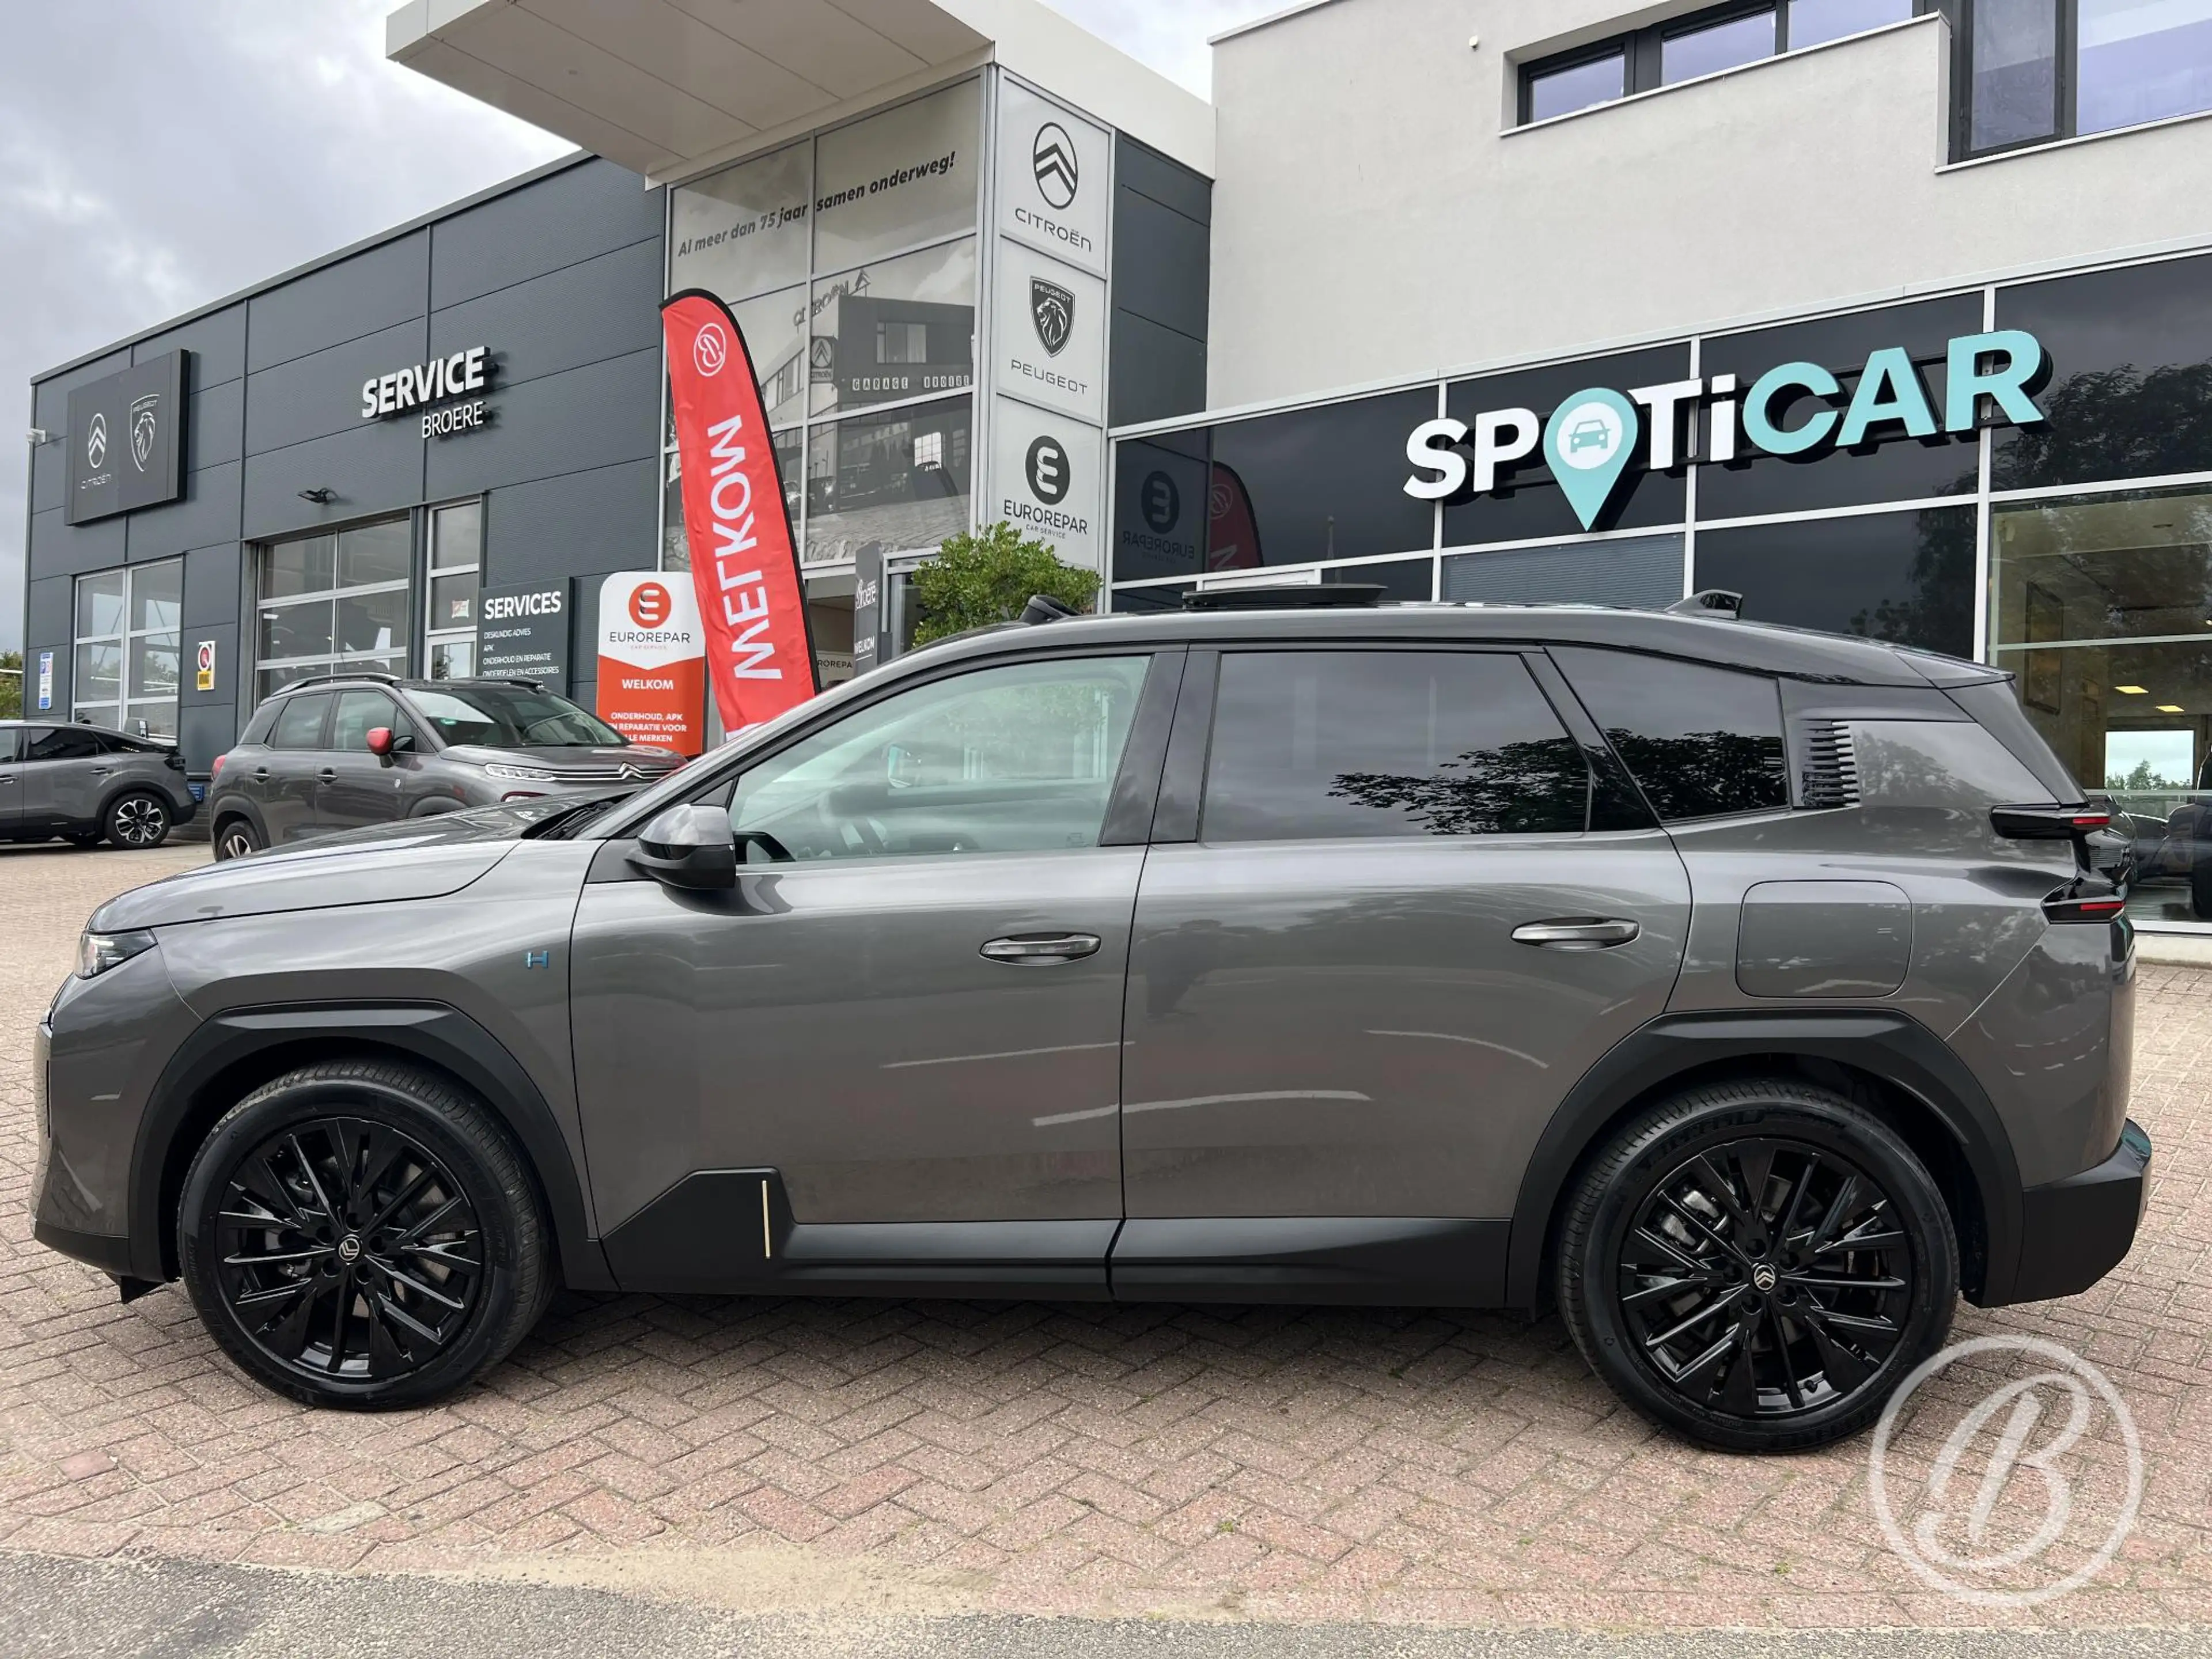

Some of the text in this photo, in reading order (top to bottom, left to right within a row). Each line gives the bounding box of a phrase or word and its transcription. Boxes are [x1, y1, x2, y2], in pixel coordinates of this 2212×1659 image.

[694, 230, 728, 251] meer
[730, 222, 756, 240] dan
[760, 212, 776, 230] 75
[777, 203, 809, 229] jaar
[816, 185, 865, 212] samen
[869, 151, 956, 194] onderweg!
[1015, 207, 1092, 252] CITROËN
[1034, 283, 1072, 303] PEUGEOT
[362, 346, 488, 419] SERVICE
[1010, 359, 1088, 395] PEUGEOT
[853, 377, 908, 391] GARAGE
[421, 401, 486, 438] BROERE
[1004, 499, 1088, 535] EUROREPAR
[1025, 523, 1066, 540] CAR SERVICE
[484, 590, 562, 620] SERVICES
[513, 627, 532, 637] ADVIES
[609, 631, 691, 643] EUROREPAR
[483, 643, 495, 653] APK
[482, 653, 551, 665] ONDERHOUD EN REPARATIE
[817, 660, 853, 669] ROREPA
[516, 668, 524, 676] EN
[525, 666, 559, 675] ACCESSOIRES
[622, 679, 674, 690] WELKOM
[611, 712, 683, 722] ONDERHOUD, APK
[619, 723, 661, 732] REPARATIE
[662, 724, 687, 732] VOOR
[639, 734, 673, 743] MERKEN
